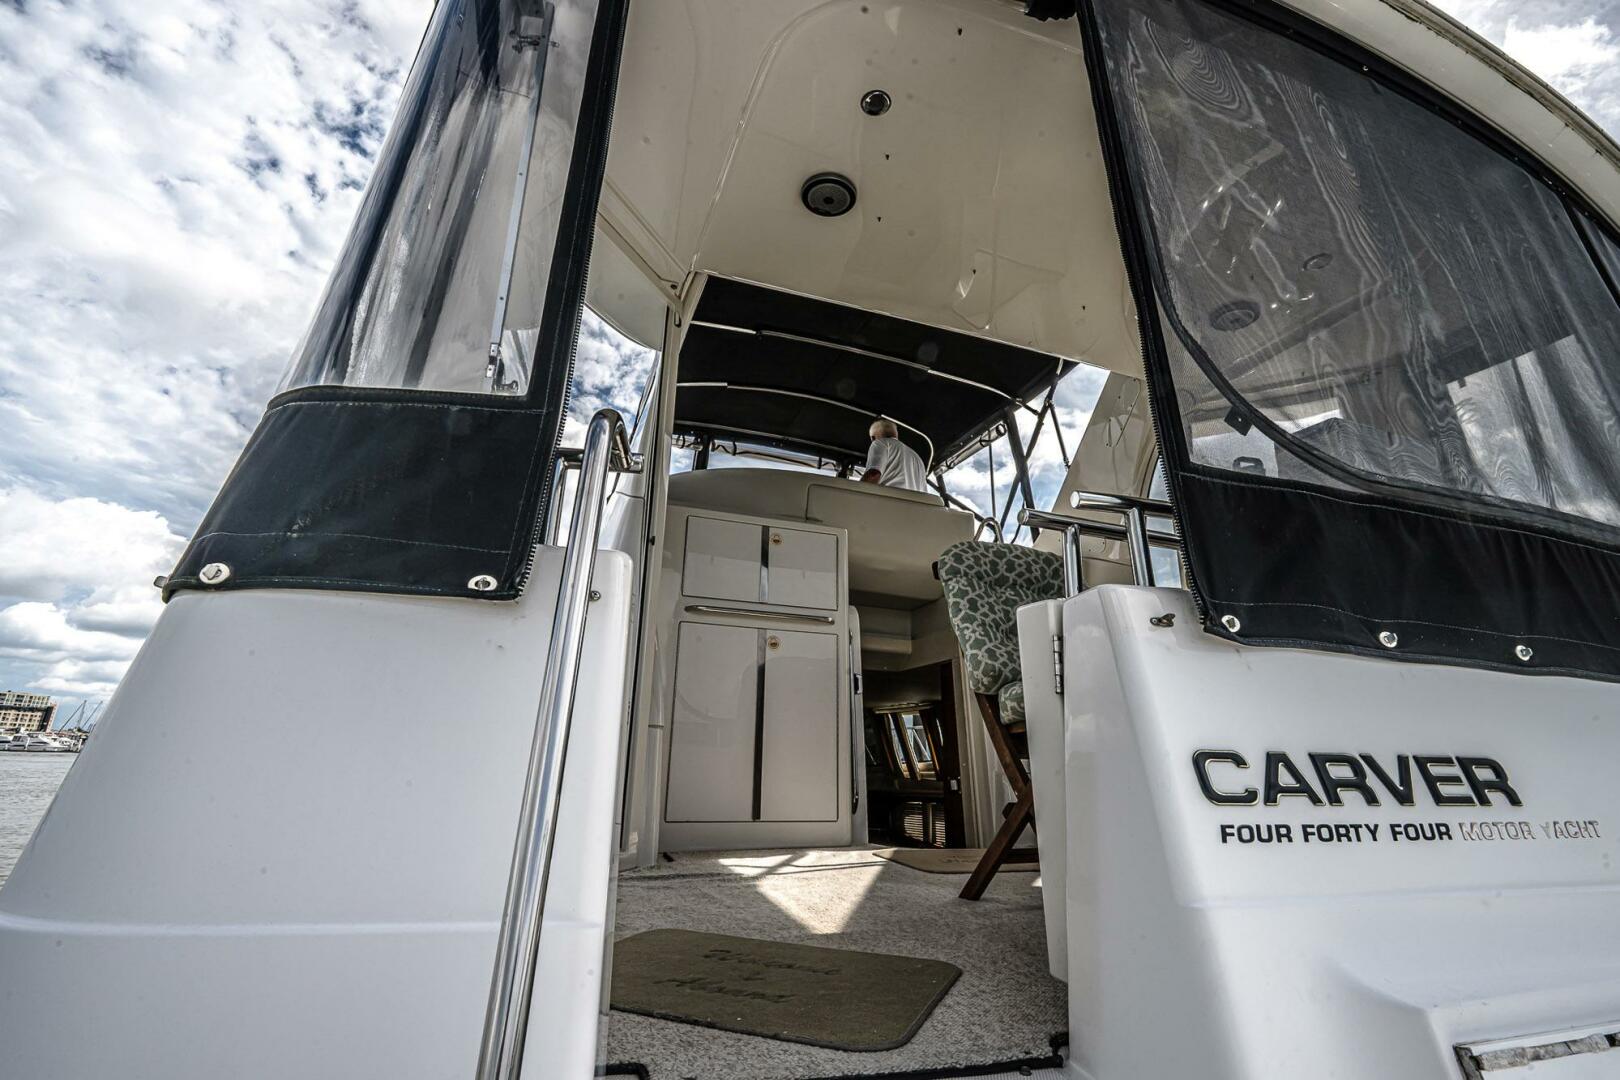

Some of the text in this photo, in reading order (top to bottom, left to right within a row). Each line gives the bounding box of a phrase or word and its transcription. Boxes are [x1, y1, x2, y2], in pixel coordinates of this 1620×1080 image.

[1192, 749, 1524, 807] CARVER
[1220, 820, 1601, 844] FOUR FORTY FOUR MOTOR YACHT
